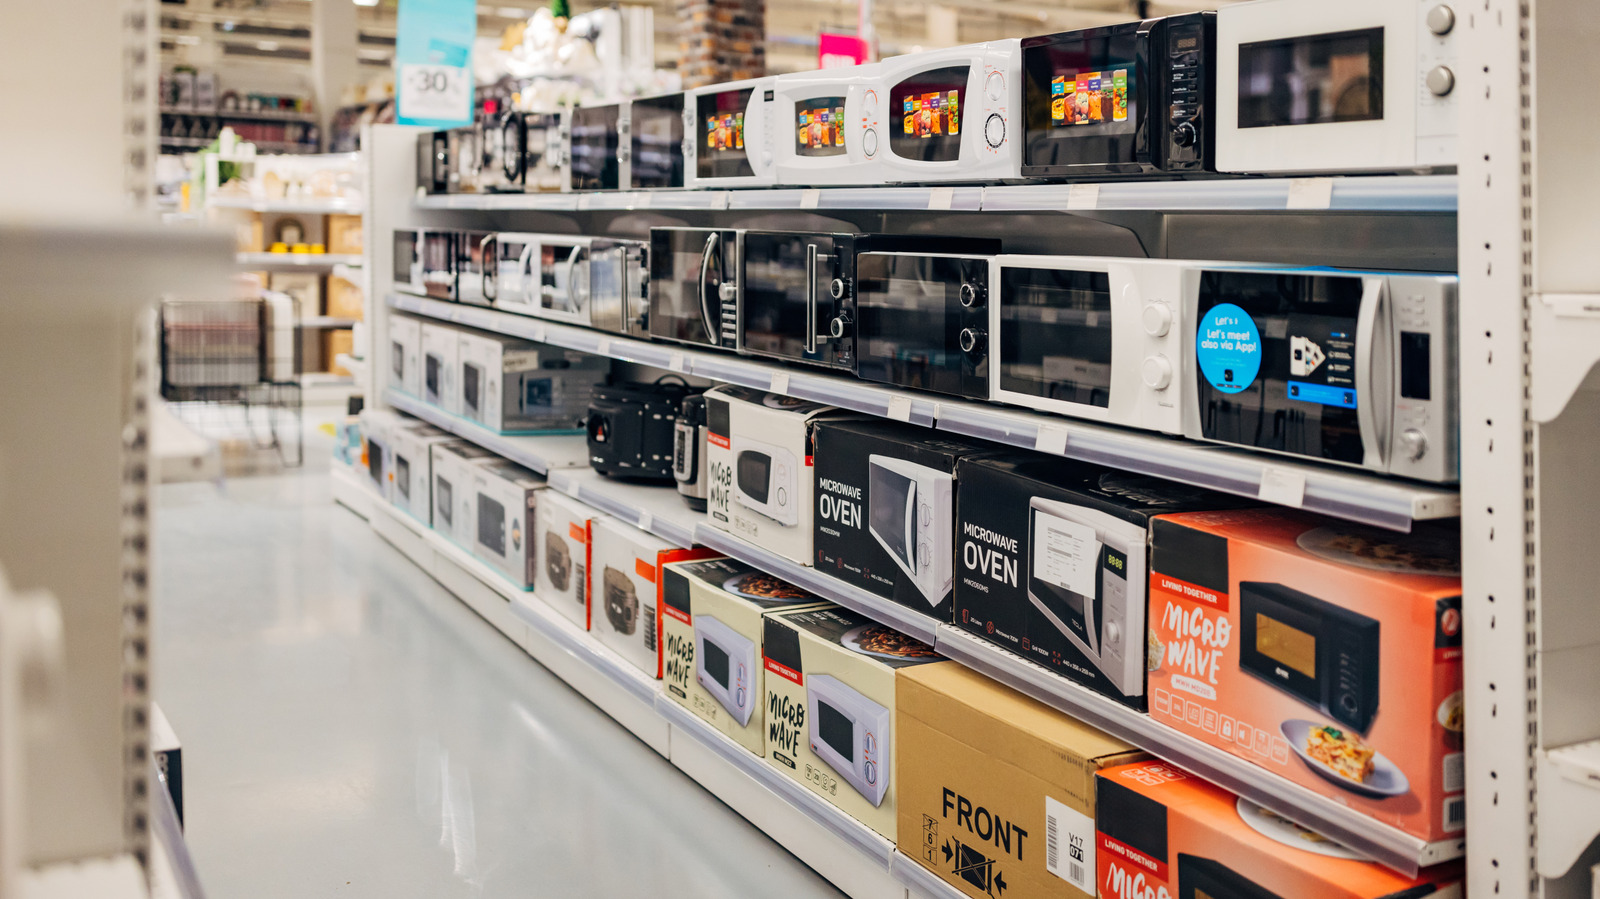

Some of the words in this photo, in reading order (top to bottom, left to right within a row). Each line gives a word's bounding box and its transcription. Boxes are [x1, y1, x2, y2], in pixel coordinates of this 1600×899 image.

[1201, 339, 1219, 350] also
[1220, 340, 1234, 351] via
[1235, 341, 1257, 353] App!
[1207, 329, 1226, 340] Let's
[1227, 331, 1250, 341] meet
[820, 477, 862, 500] MICROWAVE
[820, 493, 862, 530] OVEN
[963, 521, 1019, 554] MICROWAVE
[963, 540, 1019, 588] OVEN
[1161, 579, 1183, 592] LIVING
[1183, 586, 1218, 604] TOGETHER
[666, 658, 691, 689] WAVE
[1167, 638, 1224, 685] WAVE
[769, 721, 801, 757] WAVE
[942, 786, 1029, 861] FRONT
[927, 832, 934, 845] 6
[1068, 832, 1084, 847] V17
[927, 849, 932, 861] 1
[1070, 845, 1083, 862] 071
[1104, 838, 1125, 855] LIVING
[1125, 849, 1158, 872] TOGETHER
